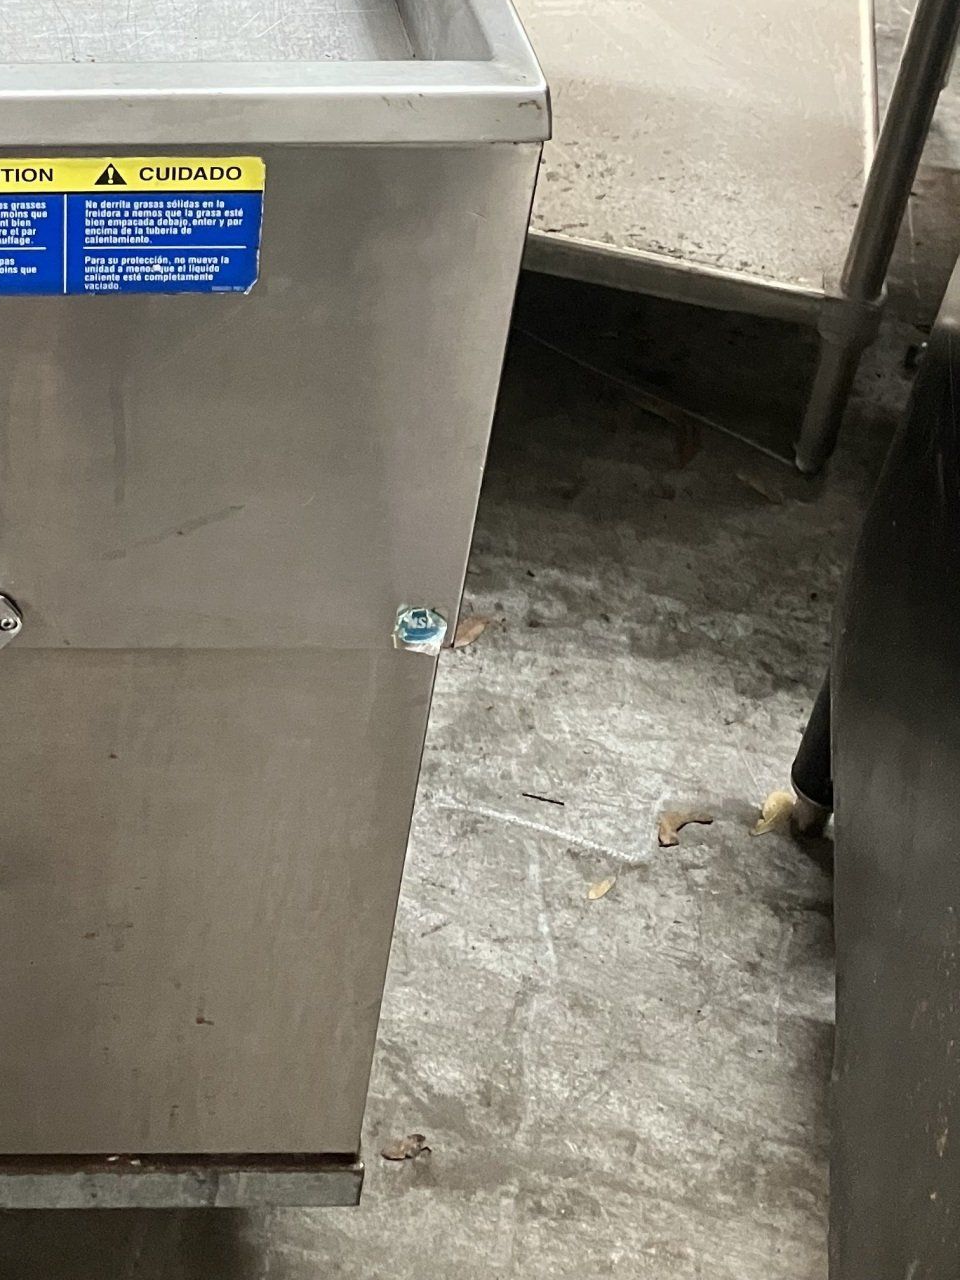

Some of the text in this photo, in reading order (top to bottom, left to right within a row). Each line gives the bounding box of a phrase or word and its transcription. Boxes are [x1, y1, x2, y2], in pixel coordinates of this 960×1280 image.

[139, 166, 242, 182] CUIDADO
[11, 202, 46, 211] grasses
[100, 200, 131, 209] derrita
[133, 201, 164, 210] grasas
[166, 199, 200, 208] sólidas
[216, 200, 225, 208] la
[0, 210, 29, 218] moins
[31, 210, 48, 219] que
[85, 209, 121, 218] freidora
[165, 210, 182, 219] que
[185, 209, 193, 217] la
[196, 210, 222, 219] grasa
[11, 219, 31, 227] bien
[85, 218, 105, 227] bien
[107, 218, 155, 228] empacada
[219, 219, 225, 227] y
[227, 219, 243, 227] por
[10, 228, 19, 236] et
[21, 228, 37, 237] par
[85, 226, 118, 235] encima
[121, 227, 132, 235] de
[135, 227, 144, 235] la
[181, 226, 192, 235] de
[85, 235, 153, 244] calentamiento.
[84, 256, 106, 265] Para
[121, 255, 172, 265] protección,
[220, 256, 230, 264] la
[20, 266, 37, 275] que
[84, 265, 116, 273] unidad
[84, 273, 121, 281] caliente
[144, 273, 214, 282] completamente
